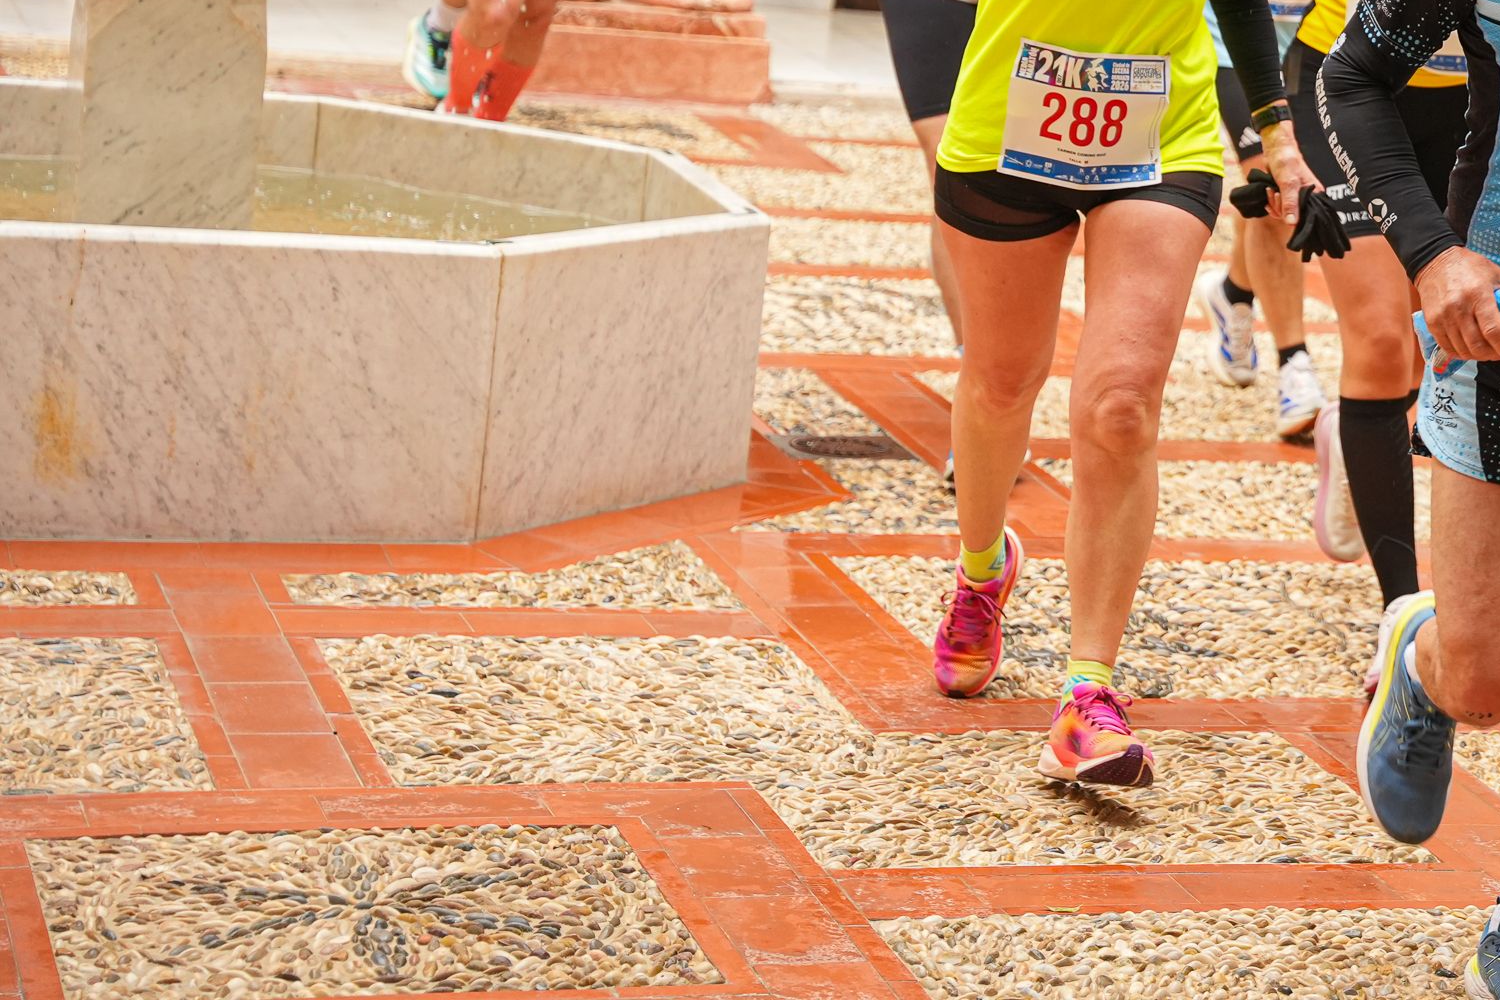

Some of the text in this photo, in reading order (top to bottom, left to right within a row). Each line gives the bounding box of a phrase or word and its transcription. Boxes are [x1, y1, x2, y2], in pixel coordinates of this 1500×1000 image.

[1034, 49, 1085, 89] 21K
[1110, 80, 1130, 91] 2026
[1039, 92, 1128, 148] 288
